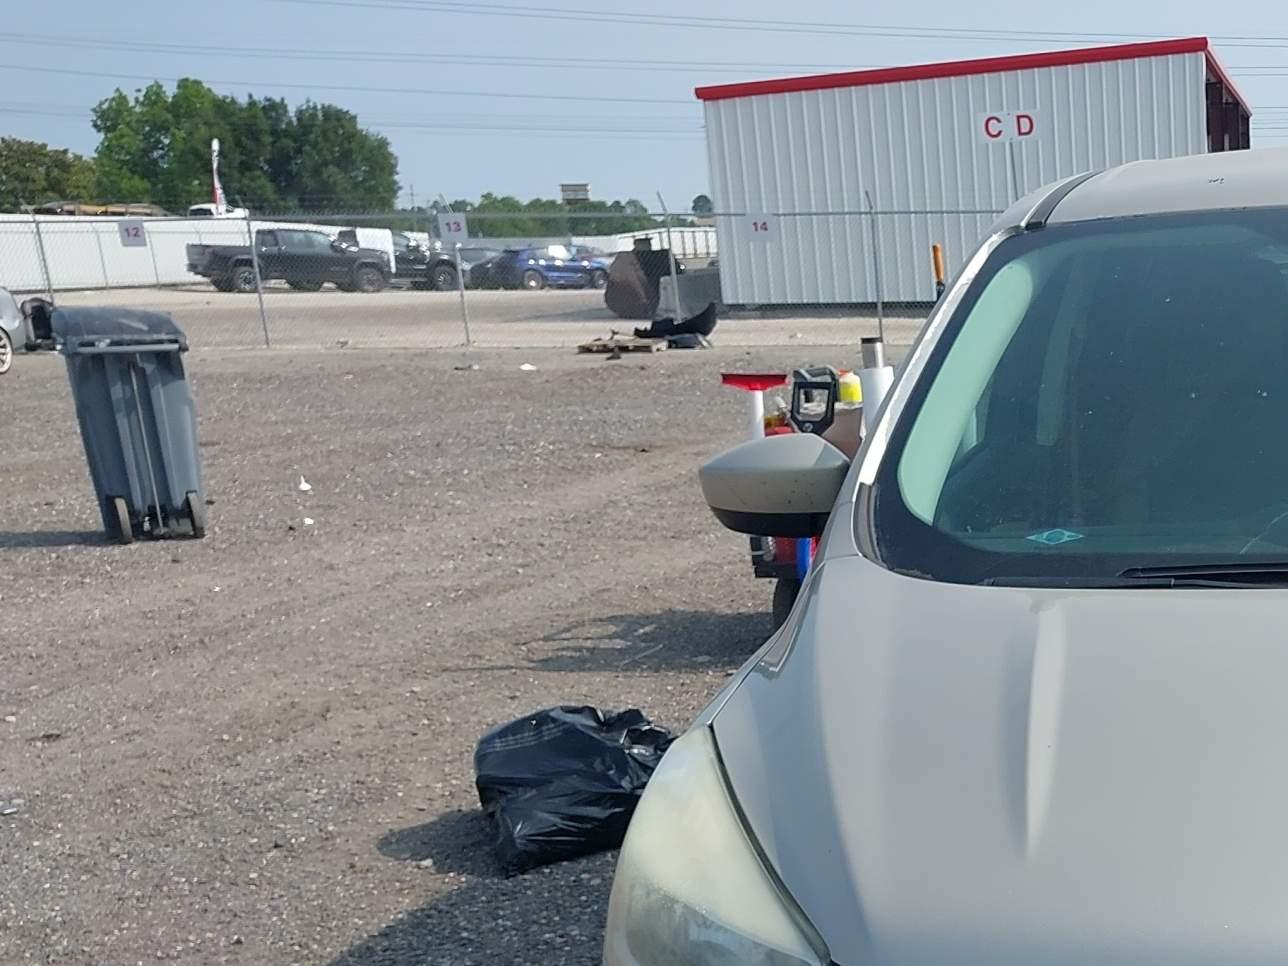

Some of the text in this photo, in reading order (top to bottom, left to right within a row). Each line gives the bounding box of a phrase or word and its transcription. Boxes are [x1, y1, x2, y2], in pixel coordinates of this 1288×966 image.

[985, 115, 1034, 138] C D
[124, 226, 141, 238] 12
[445, 221, 462, 233] 13
[752, 221, 769, 232] 14
